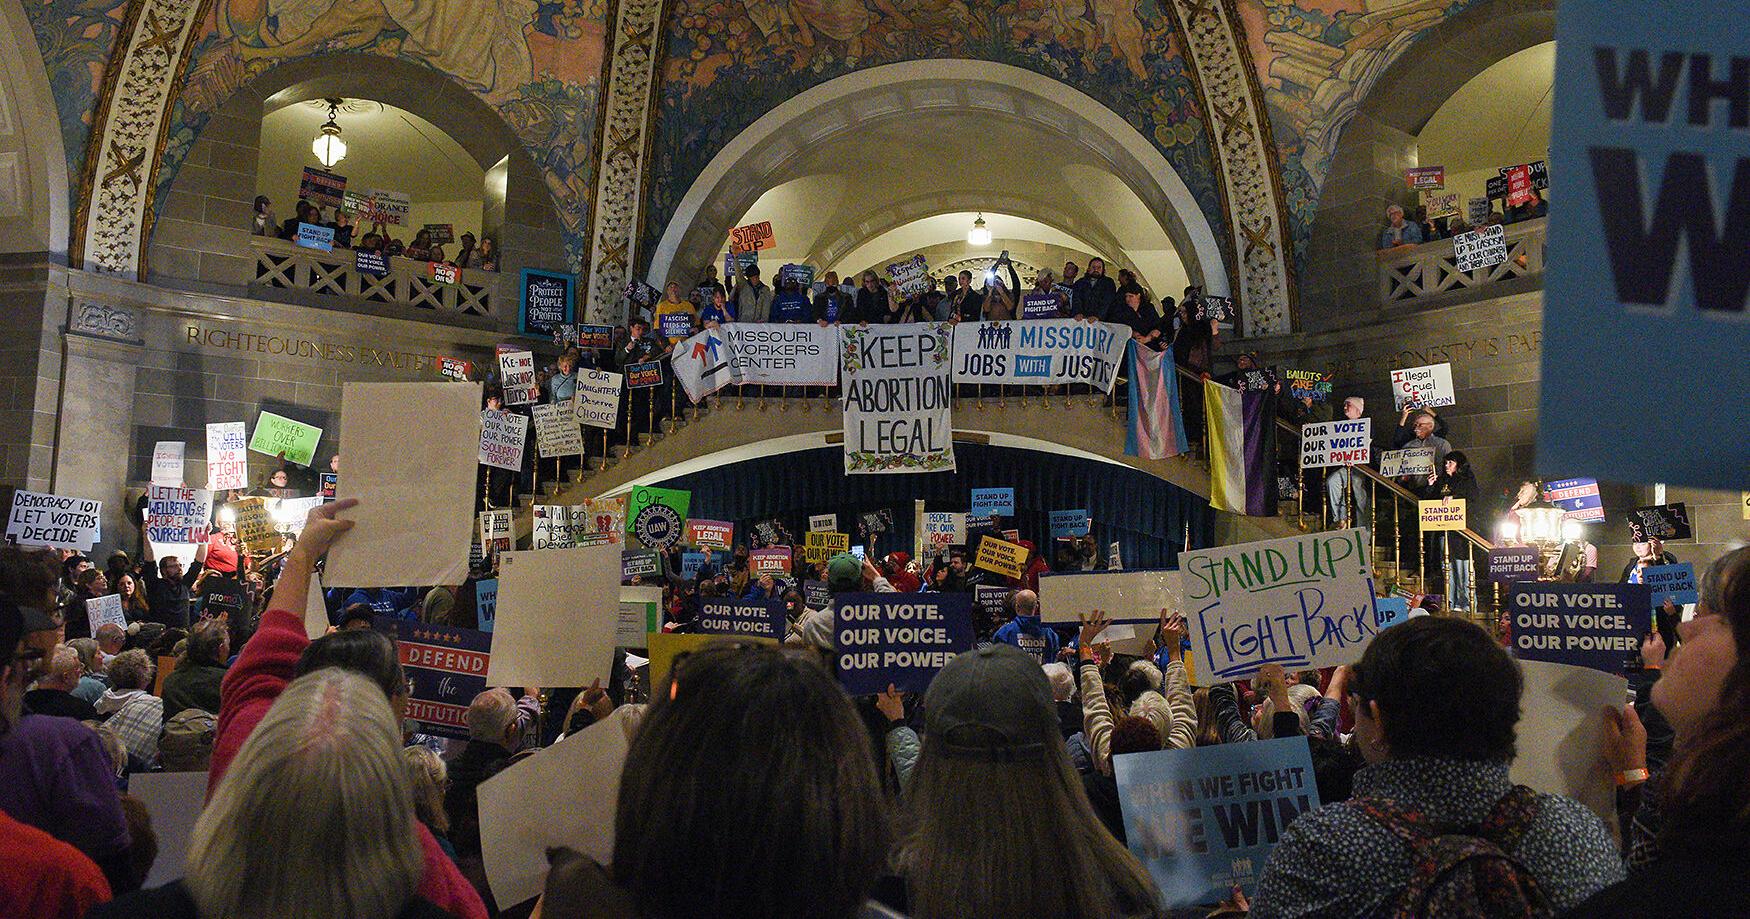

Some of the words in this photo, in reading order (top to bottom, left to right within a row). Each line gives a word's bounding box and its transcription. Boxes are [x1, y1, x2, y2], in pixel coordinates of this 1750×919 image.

[732, 221, 773, 245] STAND
[740, 241, 764, 252] UP
[1456, 245, 1466, 255] UP
[435, 268, 446, 276] NO
[446, 270, 456, 284] 3
[435, 274, 445, 283] ON
[529, 284, 563, 297] PROTECT
[529, 295, 563, 308] PEOPLE
[529, 308, 563, 321] PROFITS
[727, 331, 812, 343] MISSOURI
[1020, 325, 1115, 355] MISSOURI
[187, 326, 354, 363] RIGHTEOUSNESS
[728, 344, 820, 356] WORKERS
[860, 333, 937, 369] KEEP
[1387, 341, 1478, 369] HONESTY
[1483, 338, 1499, 358] IS
[443, 361, 454, 370] NO
[730, 357, 796, 369] CENTER
[958, 353, 1006, 377] JOBS
[1019, 359, 1047, 373] WITH
[441, 368, 453, 377] ON
[453, 365, 465, 378] 3
[589, 371, 610, 383] OUR
[629, 371, 640, 379] Our
[641, 369, 658, 377] VOICE
[1286, 369, 1322, 381] BALLOTS
[1393, 369, 1432, 383] Illegal
[577, 380, 621, 398] DAUGHTERS
[1291, 380, 1313, 390] ARE
[1402, 379, 1436, 392] Cruel
[844, 374, 950, 412] ABORTION
[1412, 390, 1434, 402] Evil
[581, 394, 614, 409] Deserve
[486, 409, 503, 420] OUR
[506, 414, 522, 425] VOTE
[576, 406, 616, 421] CHOICES
[485, 420, 502, 432] OUR
[504, 424, 522, 435] VOICE
[1304, 425, 1328, 438] OUR
[1334, 422, 1365, 433] VOTE
[273, 430, 297, 447] OVER
[482, 430, 499, 440] OUR
[501, 433, 523, 446] POWER
[860, 417, 944, 454] LEGAL
[1303, 440, 1326, 452] OUR
[1330, 436, 1364, 449] VOICE
[486, 452, 516, 466] FOREVER
[1303, 453, 1326, 466] OUR
[1330, 448, 1368, 463] POWER
[208, 460, 246, 477] FIGHT
[1382, 466, 1394, 476] All
[216, 475, 242, 489] BACK
[152, 486, 173, 500] LET
[174, 487, 196, 501] THE
[637, 489, 664, 505] Our
[1558, 487, 1591, 498] DEFEND
[14, 493, 75, 510] DEMOCRACY
[80, 501, 98, 513] 101
[148, 501, 196, 516] WELLBEING
[196, 502, 207, 513] of
[1450, 506, 1461, 514] UP
[14, 508, 46, 524] LET
[51, 511, 97, 528] VOTERS
[148, 515, 183, 528] PEOPLE
[812, 519, 833, 528] UNION
[929, 513, 952, 523] PEOPLE
[1421, 514, 1443, 522] FIGHT
[1444, 514, 1464, 522] BACK
[23, 526, 79, 543] DECIDE
[148, 527, 188, 542] SUPREME
[648, 521, 668, 534] UAW
[940, 523, 956, 533] OUR
[697, 531, 724, 541] LEGAL
[811, 534, 825, 547] OUR
[826, 534, 845, 546] VOTE
[930, 533, 955, 544] POWER
[807, 547, 822, 560] OUR
[984, 540, 998, 549] OUR
[999, 543, 1016, 555] VOTE.
[982, 548, 996, 557] OUR
[996, 552, 1017, 563] VOICE.
[1493, 555, 1520, 564] STAND
[1521, 554, 1534, 562] UP
[757, 560, 784, 569] LEGAL
[980, 555, 994, 564] OUR
[994, 560, 1019, 571] POWER.
[1187, 549, 1289, 599] STAND
[1298, 530, 1367, 579] UP!
[1490, 564, 1513, 573] FIGHT
[1513, 563, 1537, 572] BACK
[1647, 573, 1673, 583] STAND
[1674, 571, 1687, 580] UP
[1669, 581, 1694, 592] BACK
[1516, 593, 1559, 608] OUR
[1562, 593, 1623, 608] VOTE.
[703, 604, 731, 616] OUR
[734, 606, 771, 618] VOTE.
[840, 605, 880, 621] OUR
[884, 605, 944, 621] VOTE.
[702, 619, 730, 631] OUR
[733, 621, 774, 633] VOICE.
[1516, 613, 1560, 629] OUR
[1564, 614, 1633, 630] VOICE.
[840, 628, 880, 646] OUR
[884, 628, 953, 645] VOICE.
[1517, 635, 1562, 650] OUR
[1566, 636, 1639, 651] POWER
[408, 647, 484, 672] DEFEND
[840, 653, 879, 671] OUR
[1200, 775, 1235, 798] WE
[1239, 767, 1305, 796] FIGHT
